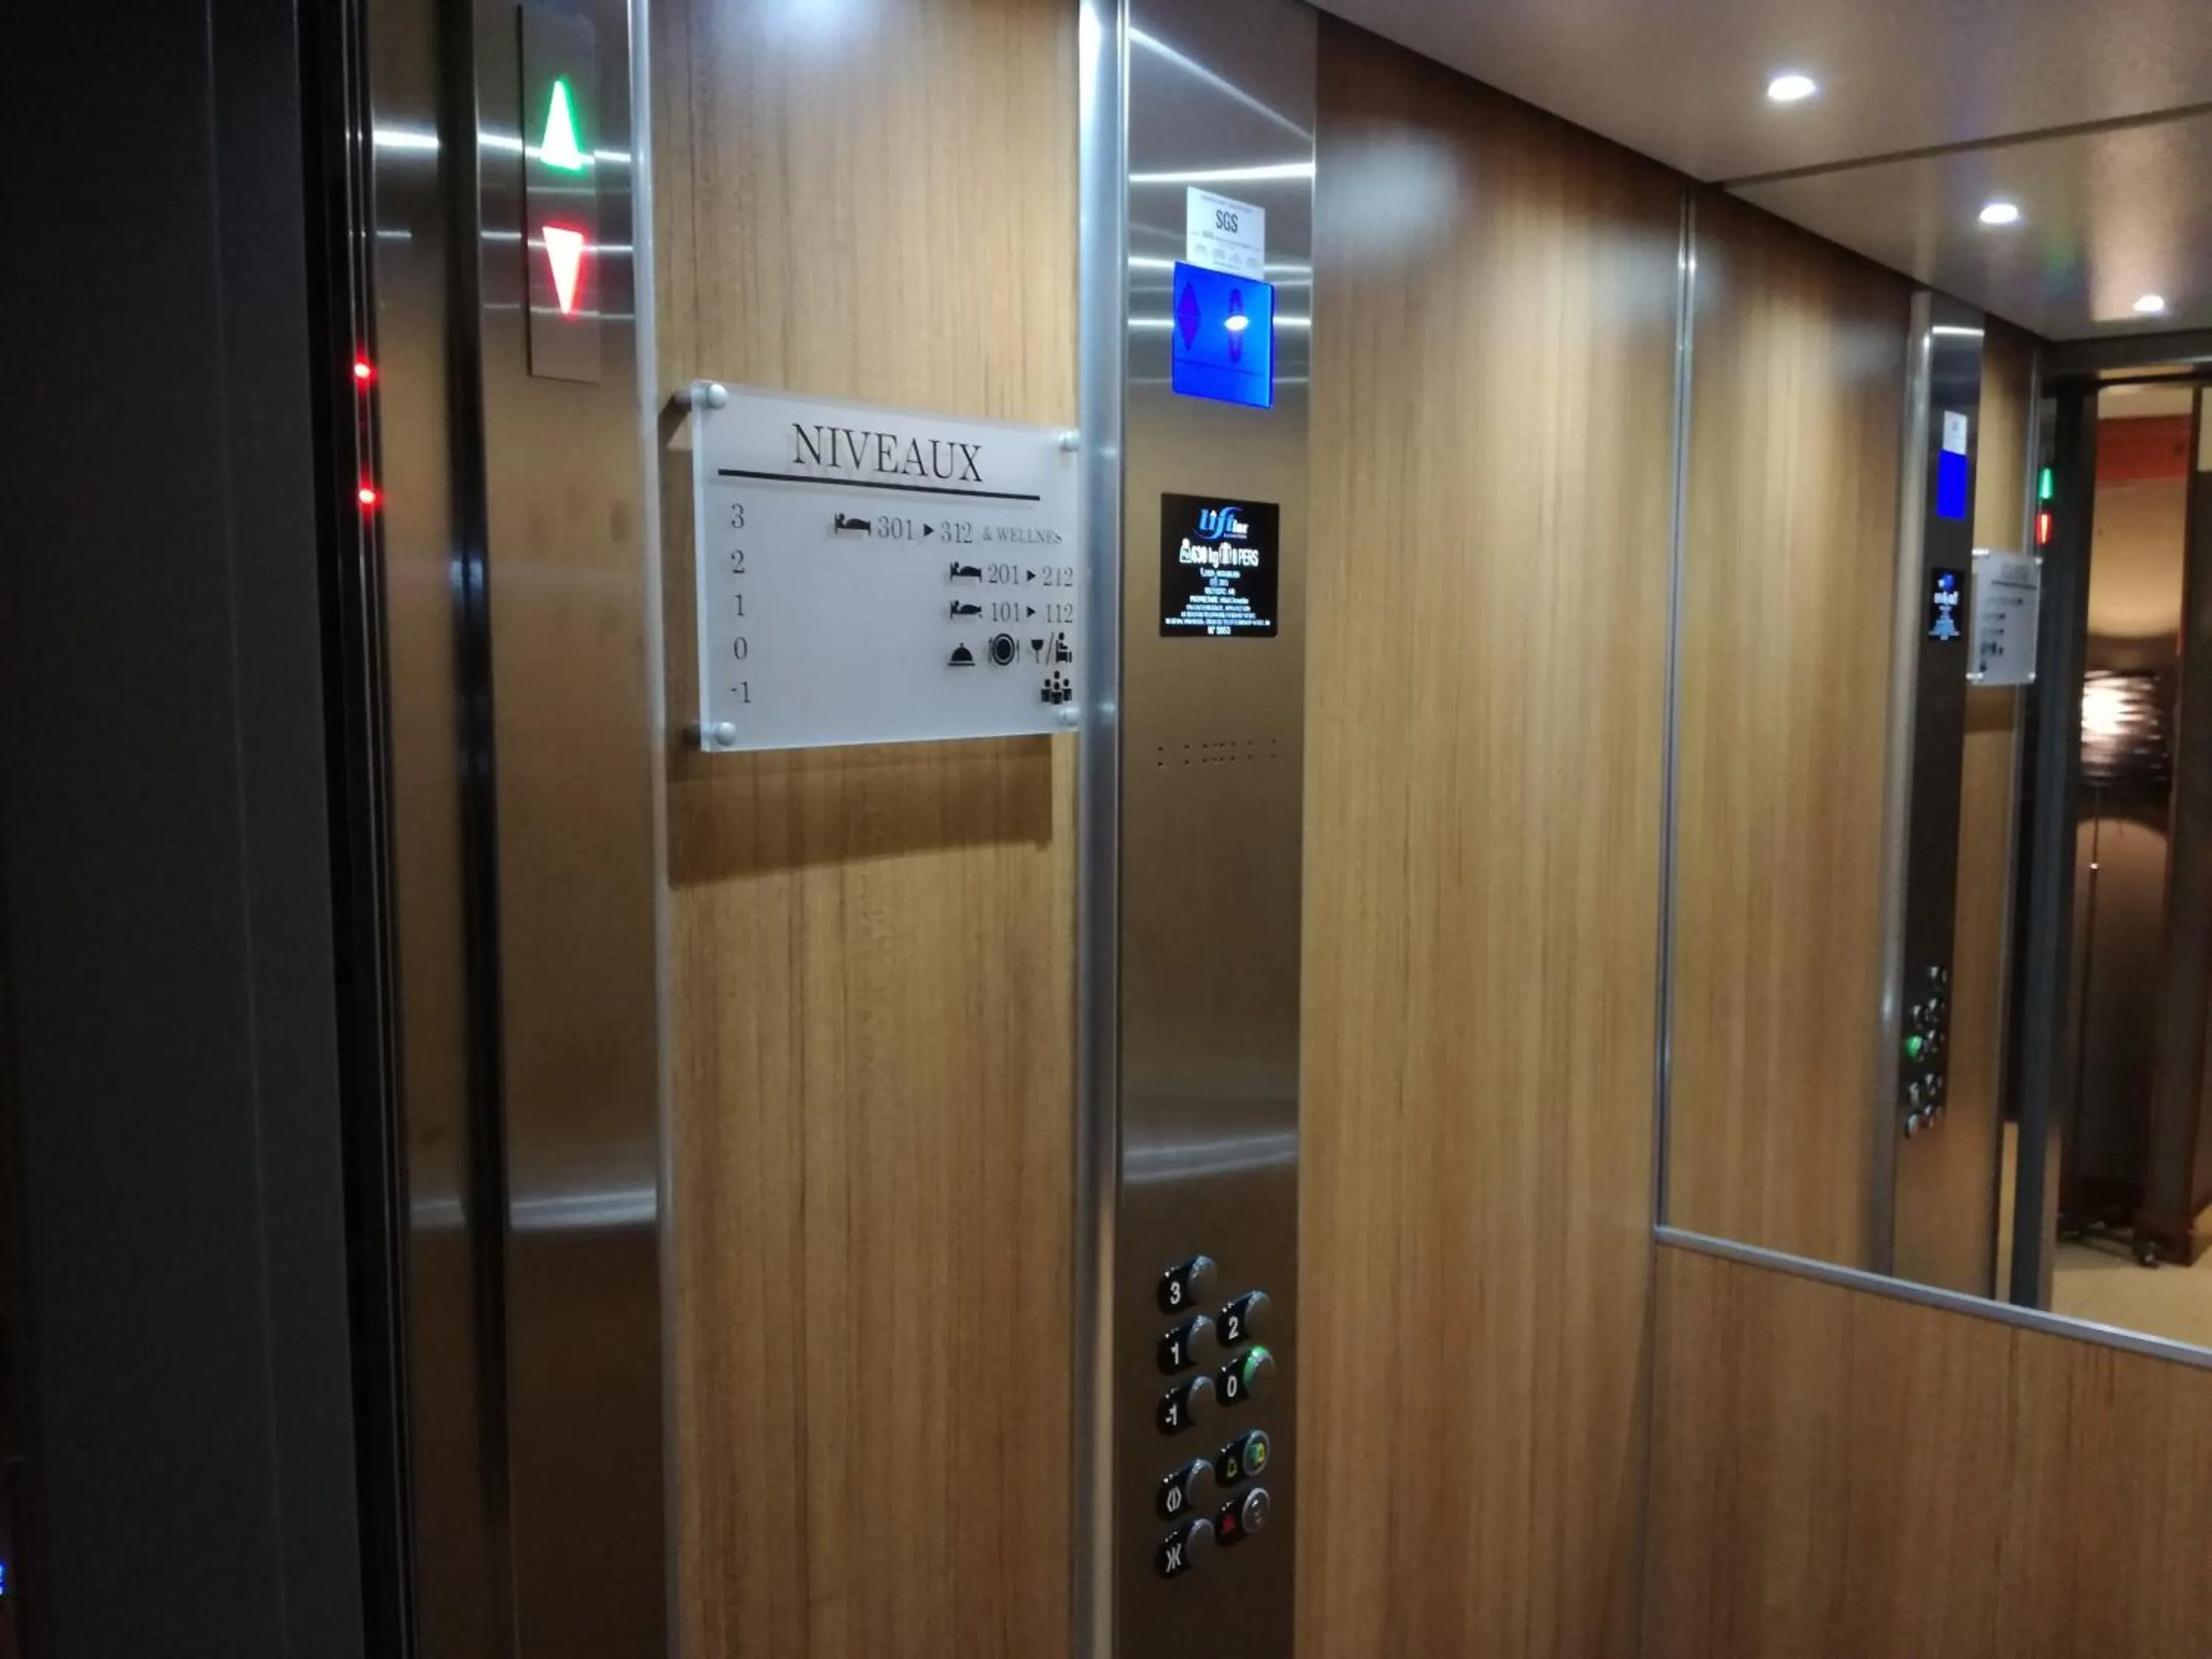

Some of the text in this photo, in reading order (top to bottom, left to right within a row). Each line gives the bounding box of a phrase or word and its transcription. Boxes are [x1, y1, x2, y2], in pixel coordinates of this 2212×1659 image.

[1216, 209, 1238, 234] SGS
[791, 423, 983, 483] NIVEAUX
[731, 504, 745, 529] 3
[877, 516, 914, 540] 301
[940, 521, 973, 544] 312
[730, 549, 1074, 588] 2 201 212
[734, 593, 1074, 625] 1 101 112
[733, 636, 748, 660] 0
[731, 681, 751, 703] -1
[1169, 1281, 1181, 1305] 3
[1228, 1315, 1239, 1340] 2
[1170, 1342, 1180, 1365] 1
[1226, 1375, 1238, 1397] 0
[1165, 1403, 1178, 1427] -1
